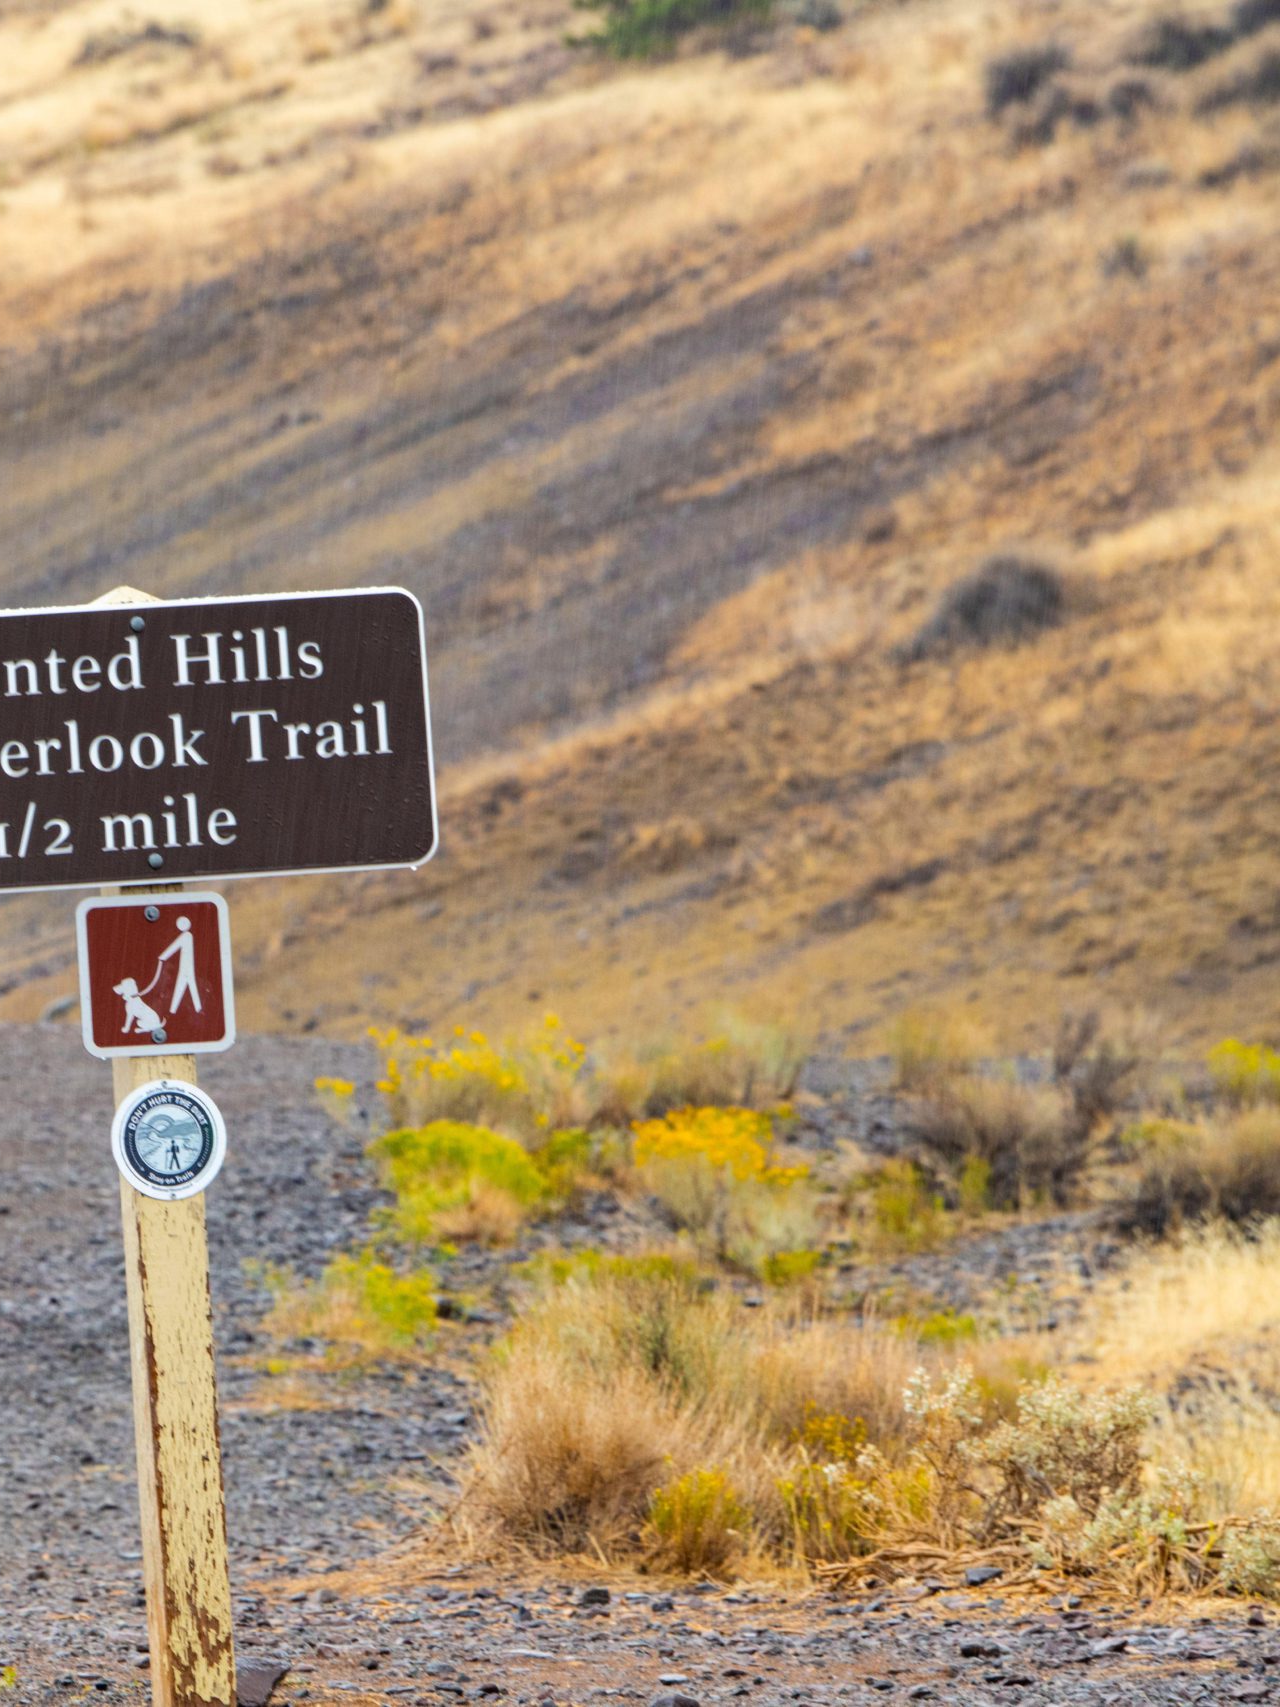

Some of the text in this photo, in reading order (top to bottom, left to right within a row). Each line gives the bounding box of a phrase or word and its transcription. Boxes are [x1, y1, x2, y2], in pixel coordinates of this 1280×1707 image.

[169, 625, 326, 687] Hills
[231, 700, 393, 762] Trail
[99, 792, 237, 852] mile
[127, 1103, 148, 1130] DON'T
[147, 1094, 173, 1109] HURT
[174, 1095, 193, 1110] THE
